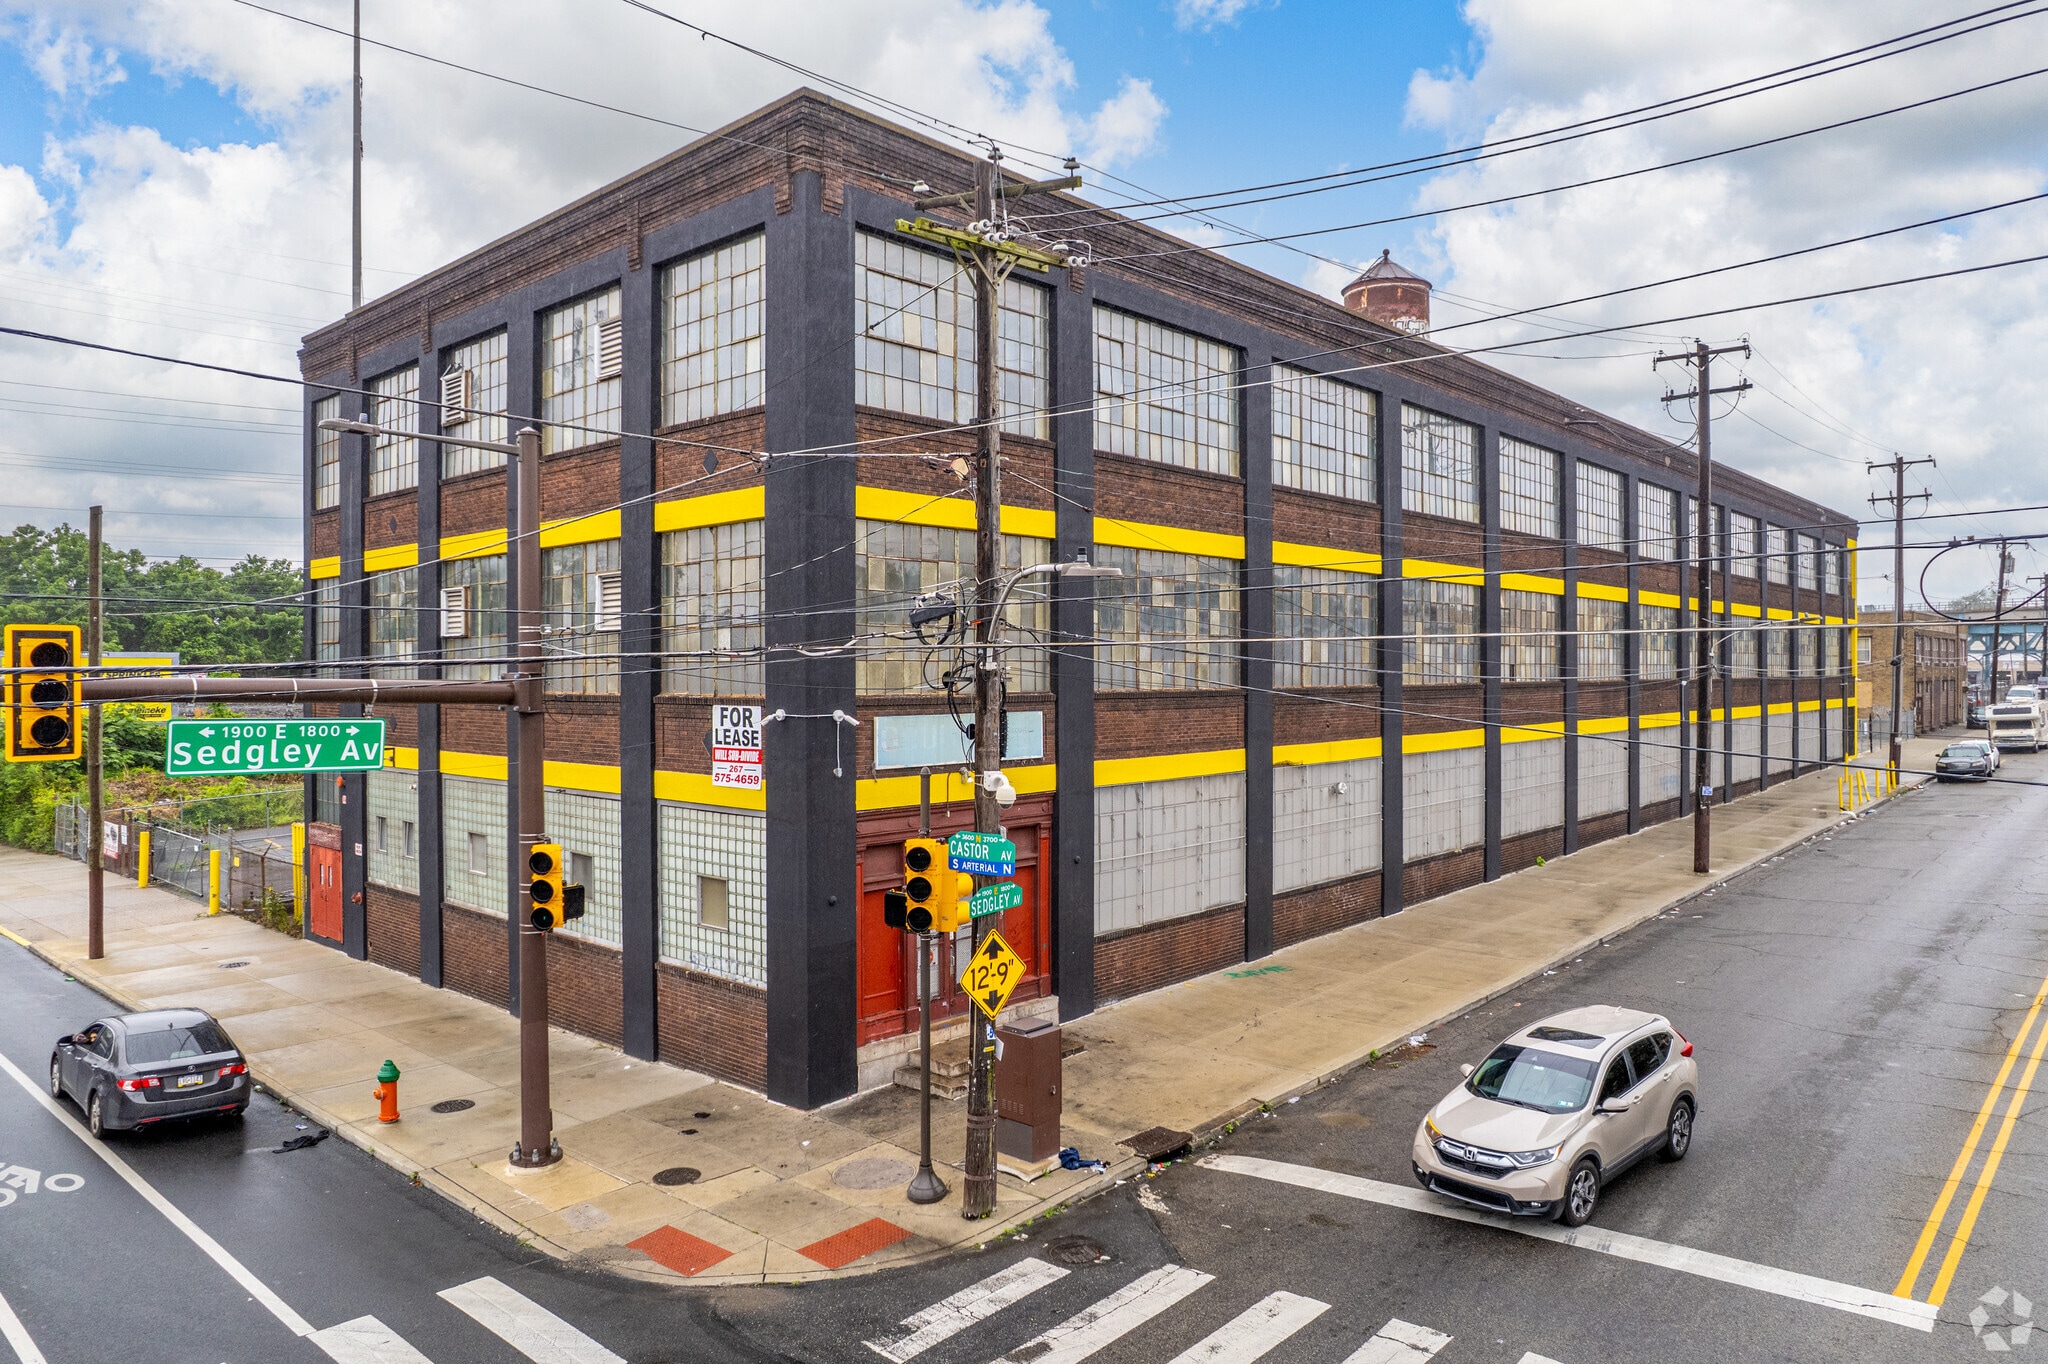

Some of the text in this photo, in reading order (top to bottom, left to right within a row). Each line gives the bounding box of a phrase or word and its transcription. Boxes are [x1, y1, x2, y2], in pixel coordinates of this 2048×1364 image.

[720, 707, 754, 729] FOR
[222, 724, 341, 739] 1900 E 1800
[714, 728, 759, 747] LEASE
[173, 739, 380, 770] Sedgley Av
[714, 749, 760, 763] WILL SUB-DIVIDE
[729, 765, 743, 773] 267
[714, 773, 760, 785] 575-4659
[975, 835, 982, 843] N
[950, 840, 1012, 861] CASTOR AV
[952, 858, 1012, 875] S ARTERIAL N
[982, 884, 1011, 897] 1900 E 1800
[971, 892, 1021, 916] SEDGLEY AV
[970, 958, 1014, 992] 12'-9"
